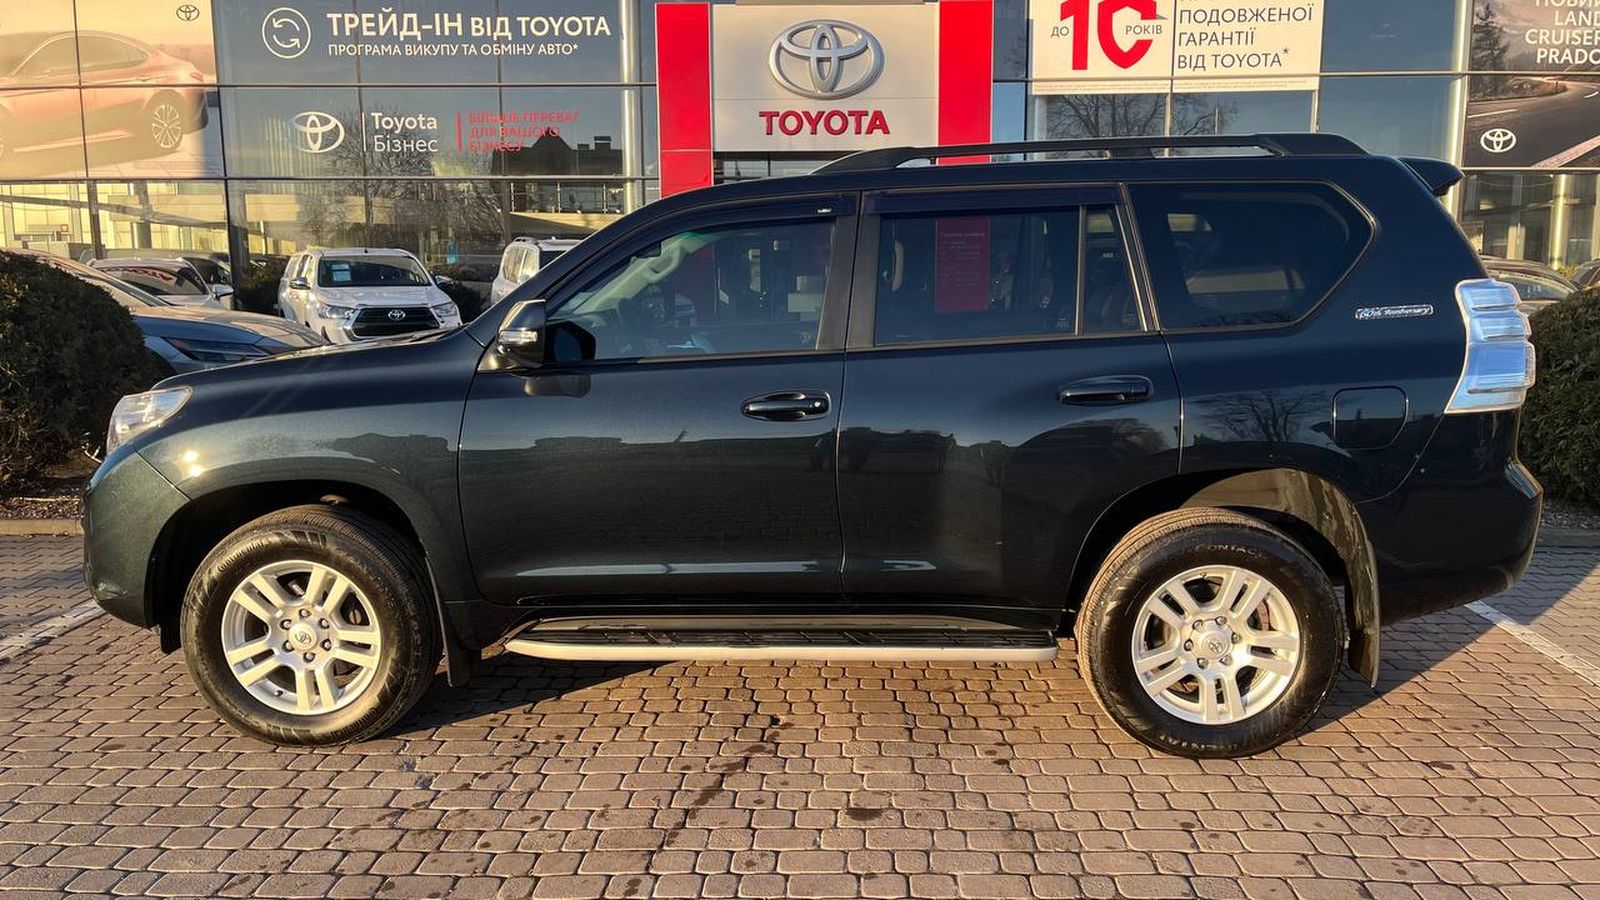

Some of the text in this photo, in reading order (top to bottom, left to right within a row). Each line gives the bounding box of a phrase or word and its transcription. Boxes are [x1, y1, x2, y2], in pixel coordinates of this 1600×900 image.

[326, 7, 612, 41] ТРЕЙД-ІН ВІД TOYOTA
[1179, 3, 1315, 26] ПОДОВЖЕНОЇ
[1051, 26, 1070, 38] ДО
[1125, 24, 1163, 36] РОКІВ
[1178, 27, 1257, 47] ГАРАНТІЇ
[328, 44, 402, 56] ПРОГРАМА
[405, 44, 459, 56] ВИКУПУ
[461, 44, 478, 56] ТА
[480, 43, 535, 56] ОБМІНУ
[1536, 48, 1600, 65] PRADO
[1177, 54, 1206, 72] ВІД
[371, 112, 438, 134] Toyota
[758, 110, 890, 136] TOYOTA
[373, 134, 438, 152] Бізнес
